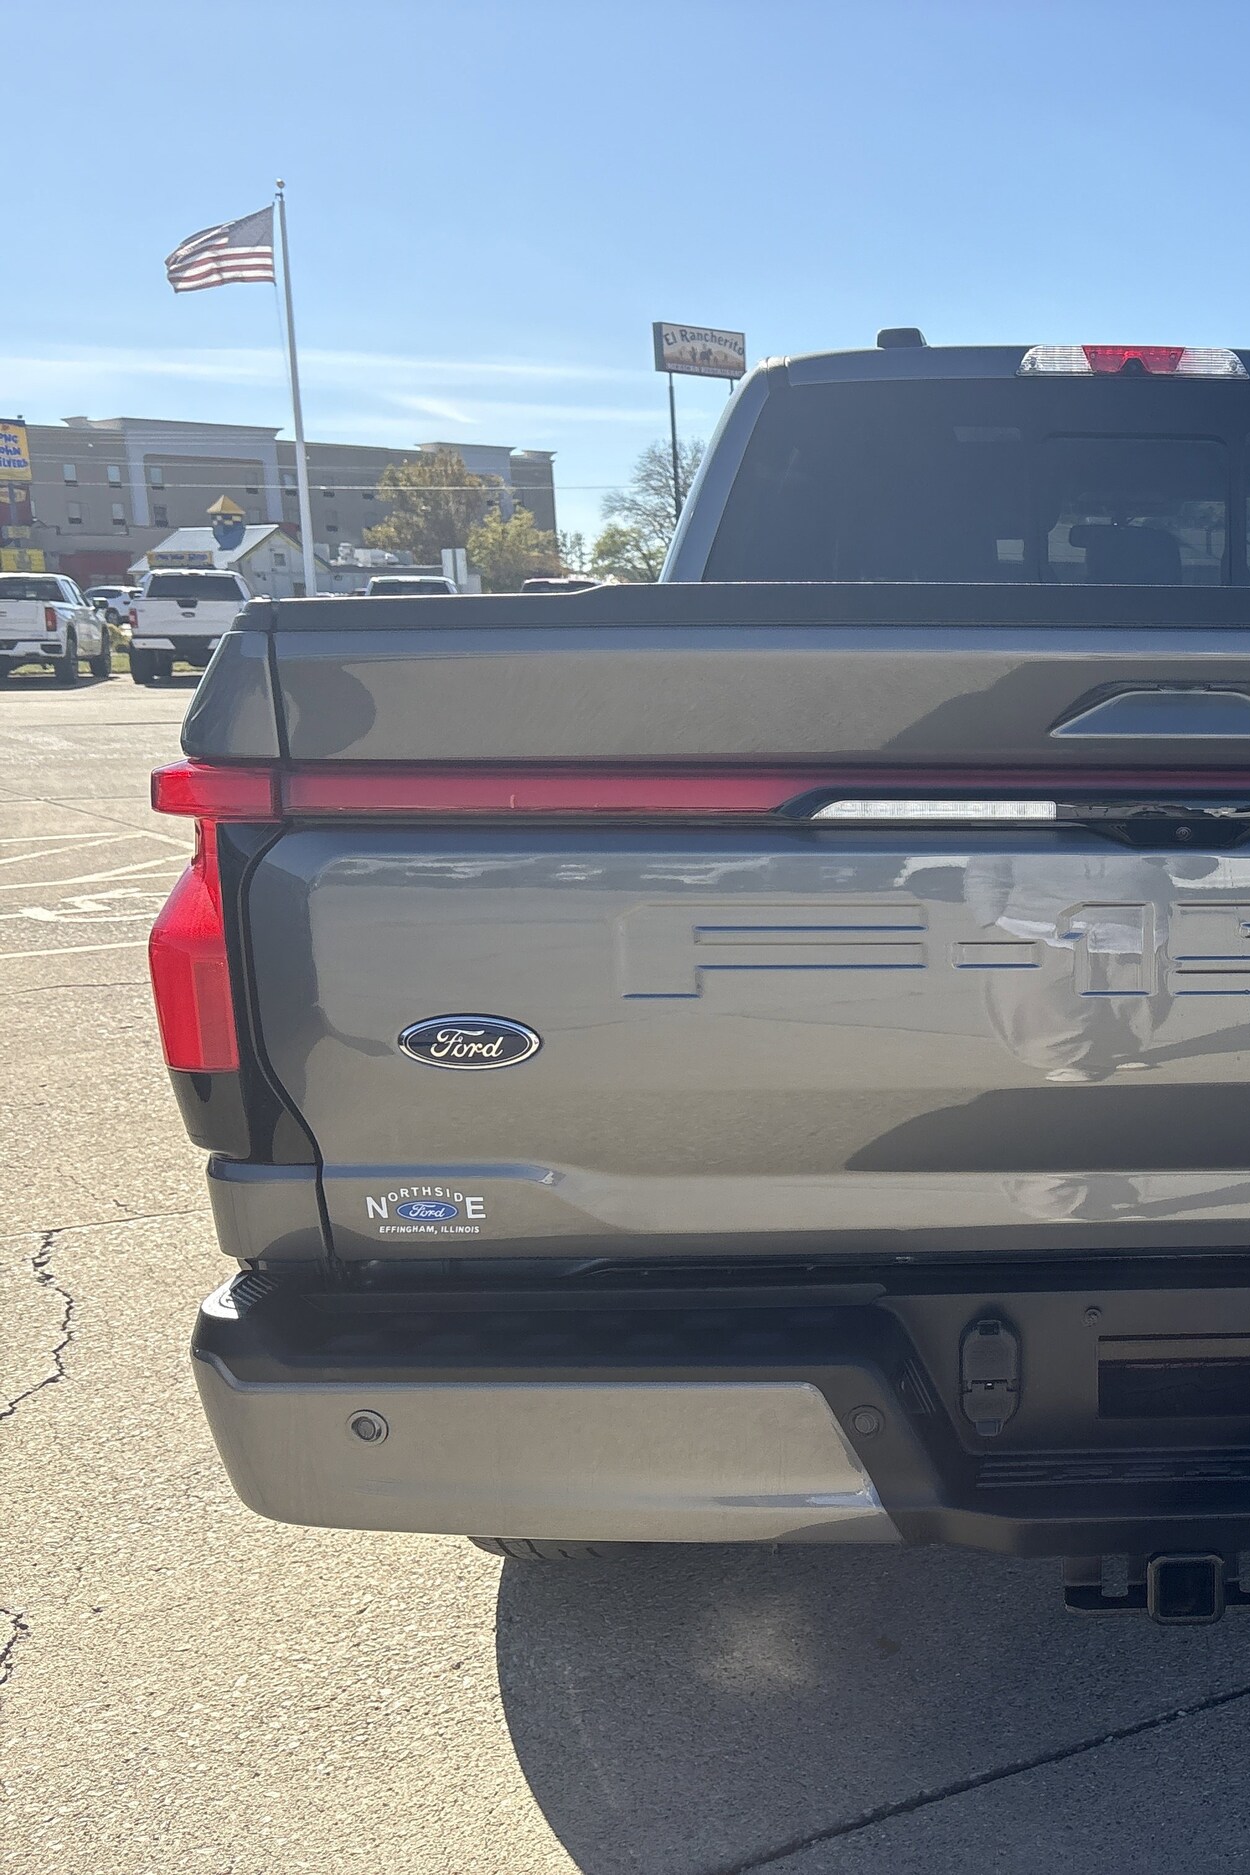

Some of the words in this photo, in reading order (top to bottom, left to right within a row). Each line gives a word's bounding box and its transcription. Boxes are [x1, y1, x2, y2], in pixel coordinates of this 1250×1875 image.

[663, 331, 677, 346] El
[679, 329, 744, 356] Rancherito
[430, 1028, 504, 1058] Ford
[366, 1186, 487, 1219] NORTHSIDE
[408, 1203, 446, 1218] Ford
[379, 1225, 438, 1235] EFFINGHAM,
[440, 1225, 480, 1234] ILLINOIS
